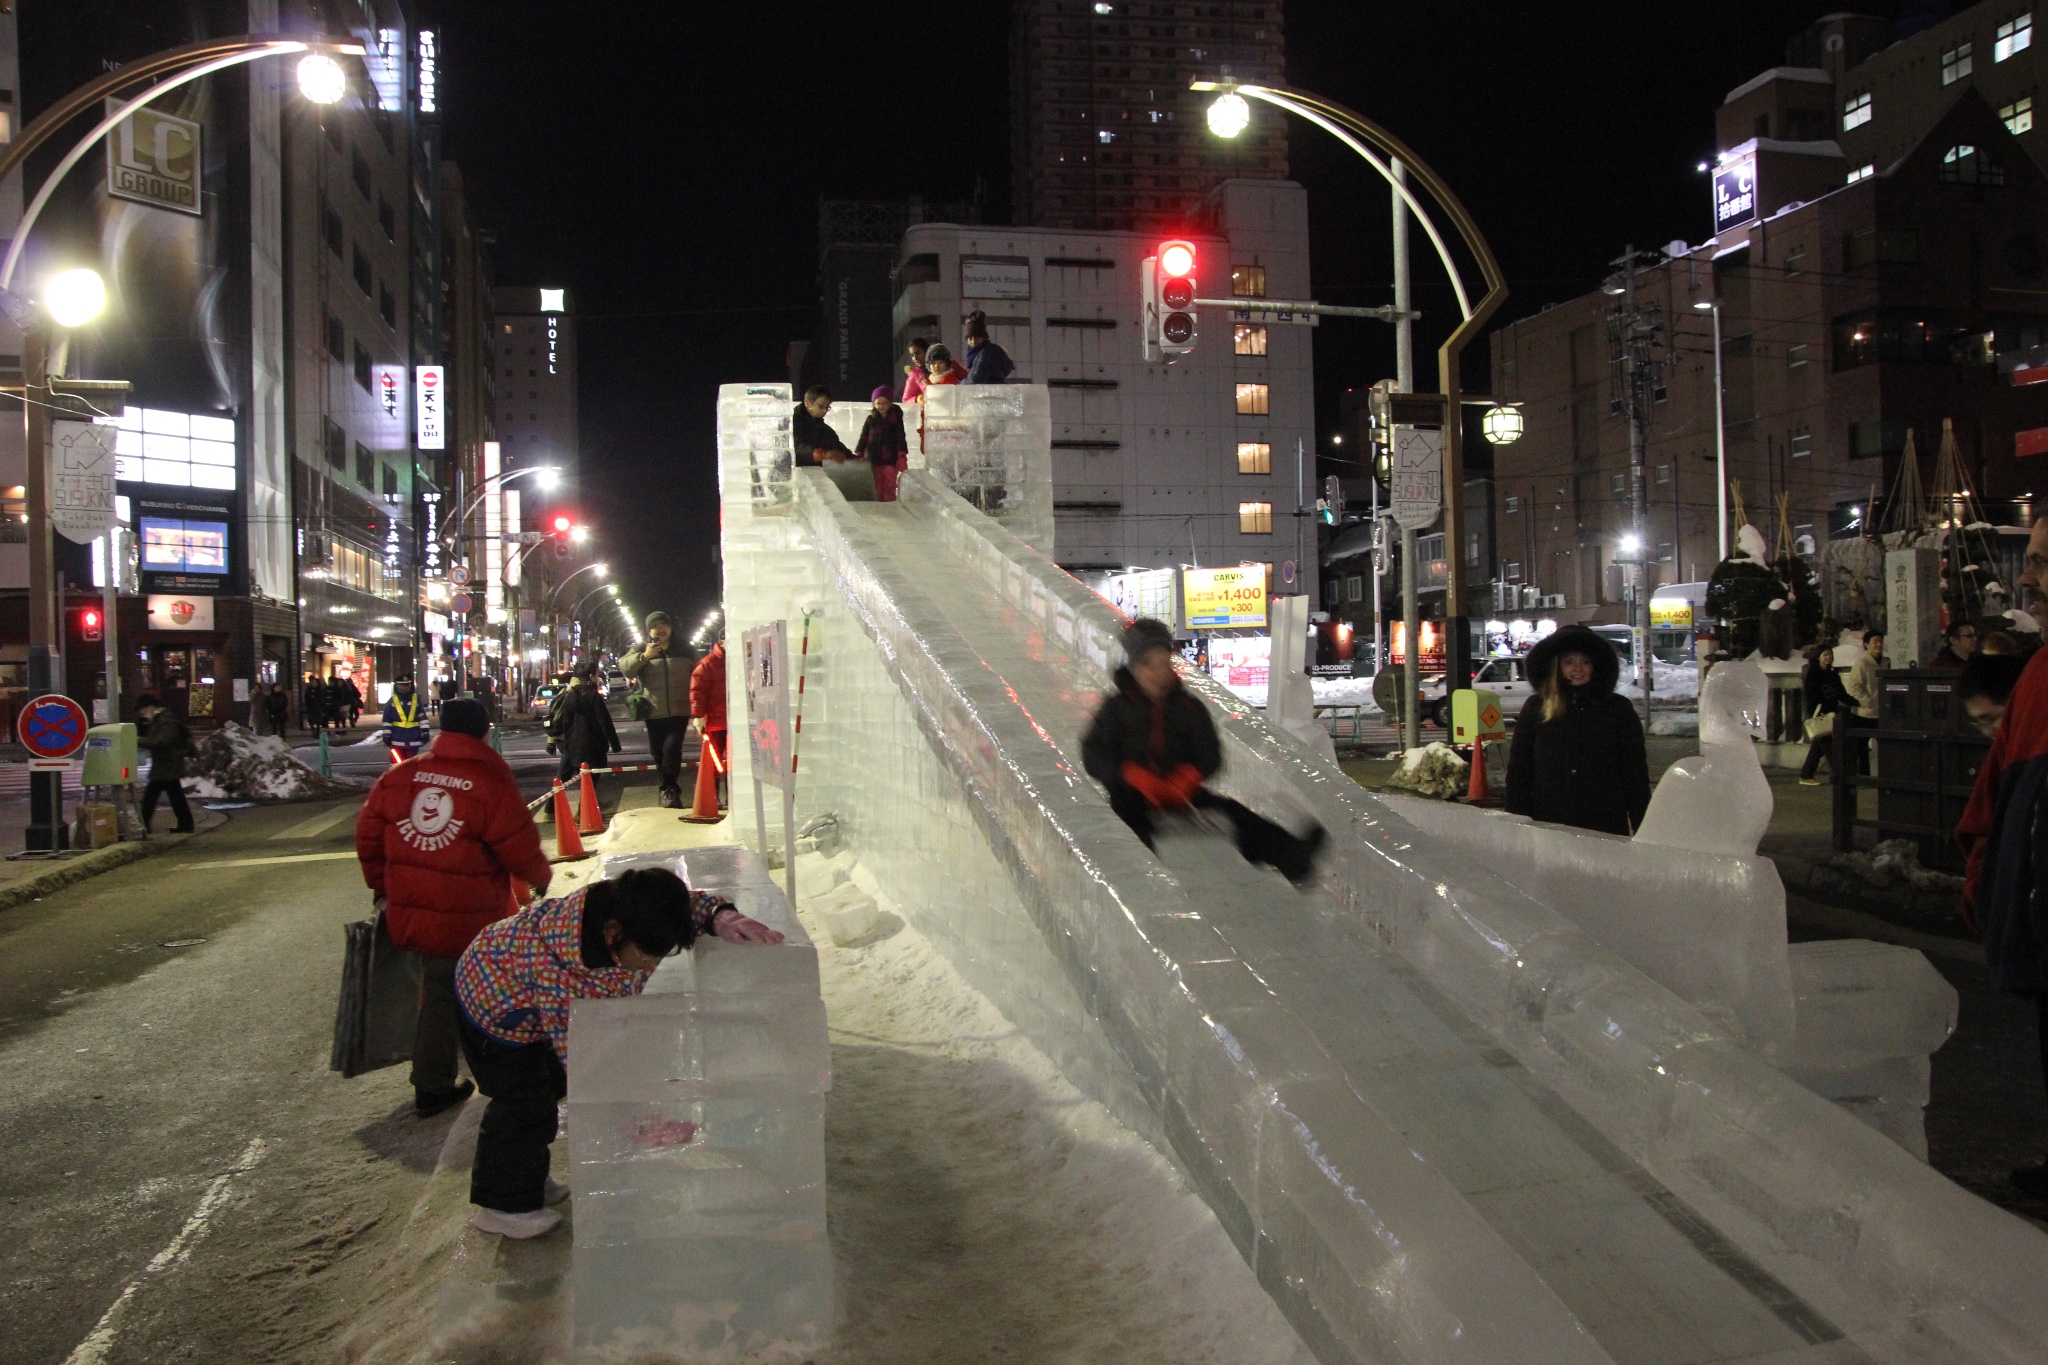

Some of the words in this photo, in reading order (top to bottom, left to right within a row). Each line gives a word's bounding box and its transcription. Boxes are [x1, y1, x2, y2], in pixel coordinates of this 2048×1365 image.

[121, 171, 193, 203] GROUP
[963, 275, 987, 283] Space
[548, 317, 557, 374] HOTEL
[1395, 485, 1439, 500] SUSUKINO
[1213, 573, 1244, 581] CARVIS
[1218, 588, 1261, 601] ¥1,400
[1231, 603, 1253, 612] ¥300
[413, 771, 473, 790] SUSUKINO
[396, 818, 416, 842] ICE
[413, 818, 464, 851] FESTIVAL
